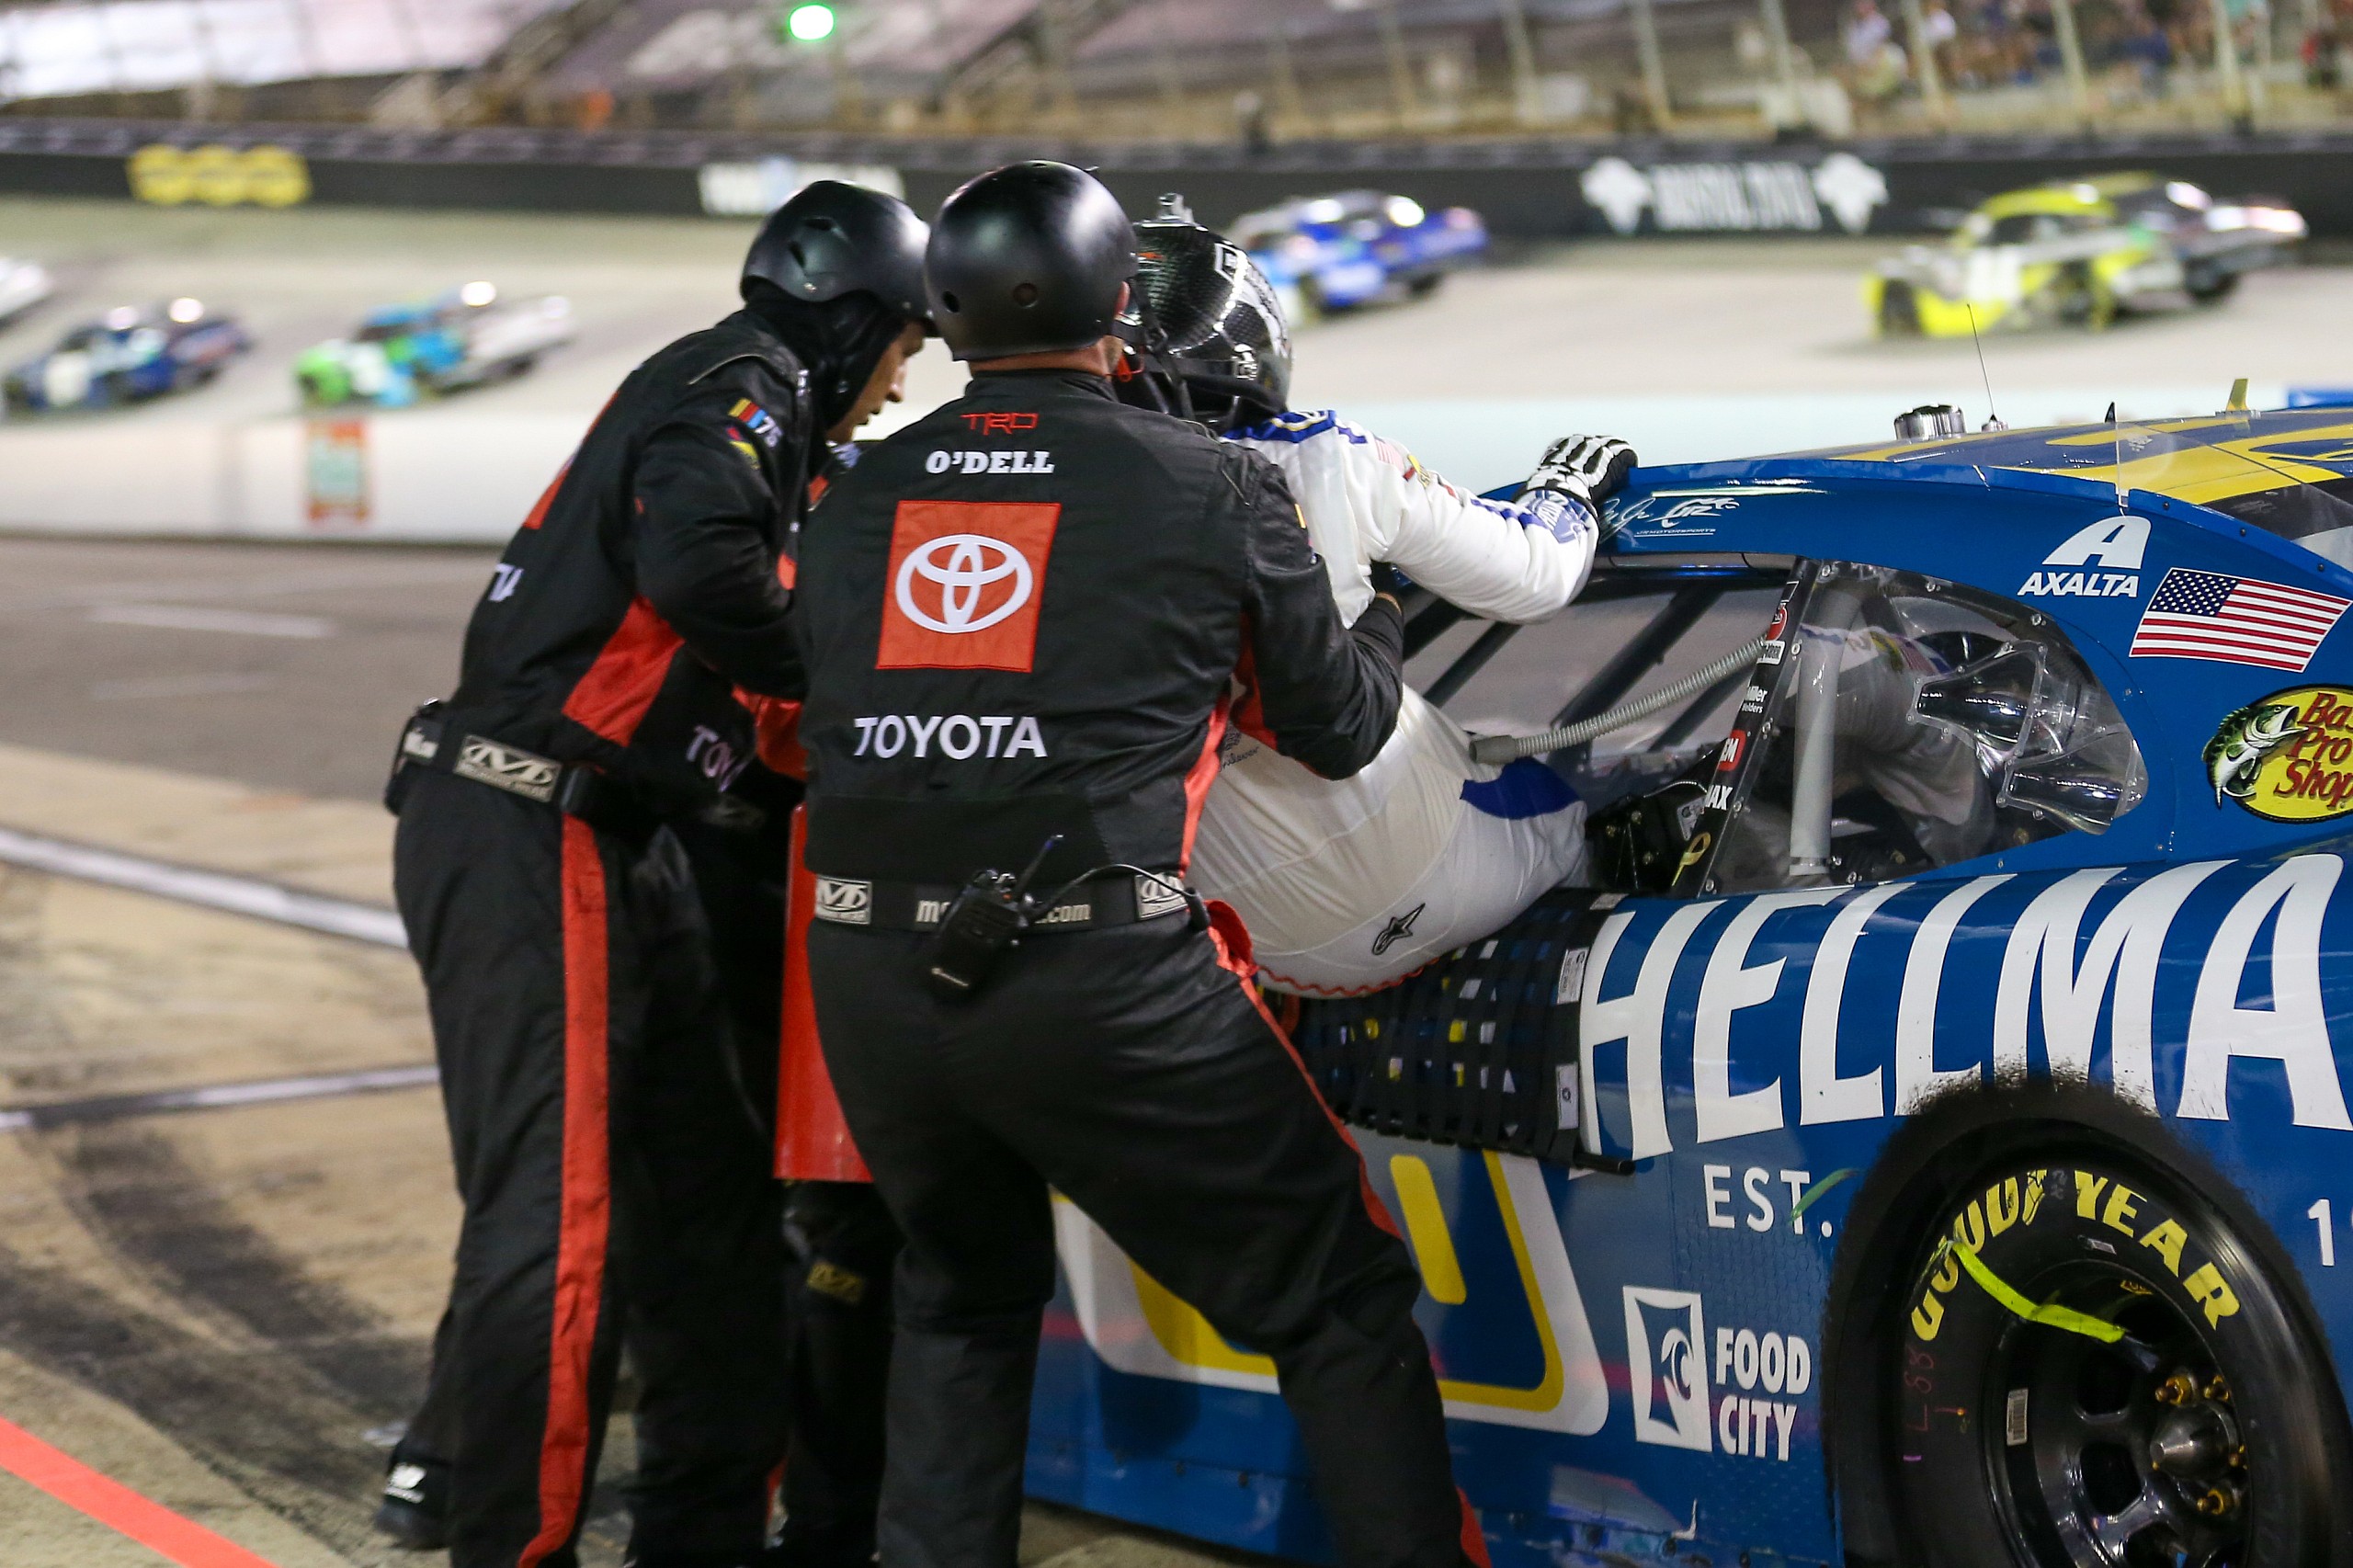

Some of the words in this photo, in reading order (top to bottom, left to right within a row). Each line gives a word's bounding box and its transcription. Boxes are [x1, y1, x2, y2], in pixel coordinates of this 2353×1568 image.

[960, 412, 1039, 436] TRD
[926, 450, 1055, 474] O'DELL
[2017, 572, 2140, 598] AXALTA
[2297, 691, 2353, 733] Ba
[853, 714, 1048, 760] TOYOTA
[2285, 725, 2352, 766] Pro
[1568, 854, 2353, 1179] HELLMA
[1703, 1164, 1833, 1237] EST.
[2308, 1199, 2353, 1267] 1
[1715, 1327, 1812, 1395] FOOD
[1719, 1394, 1798, 1462] CITY
